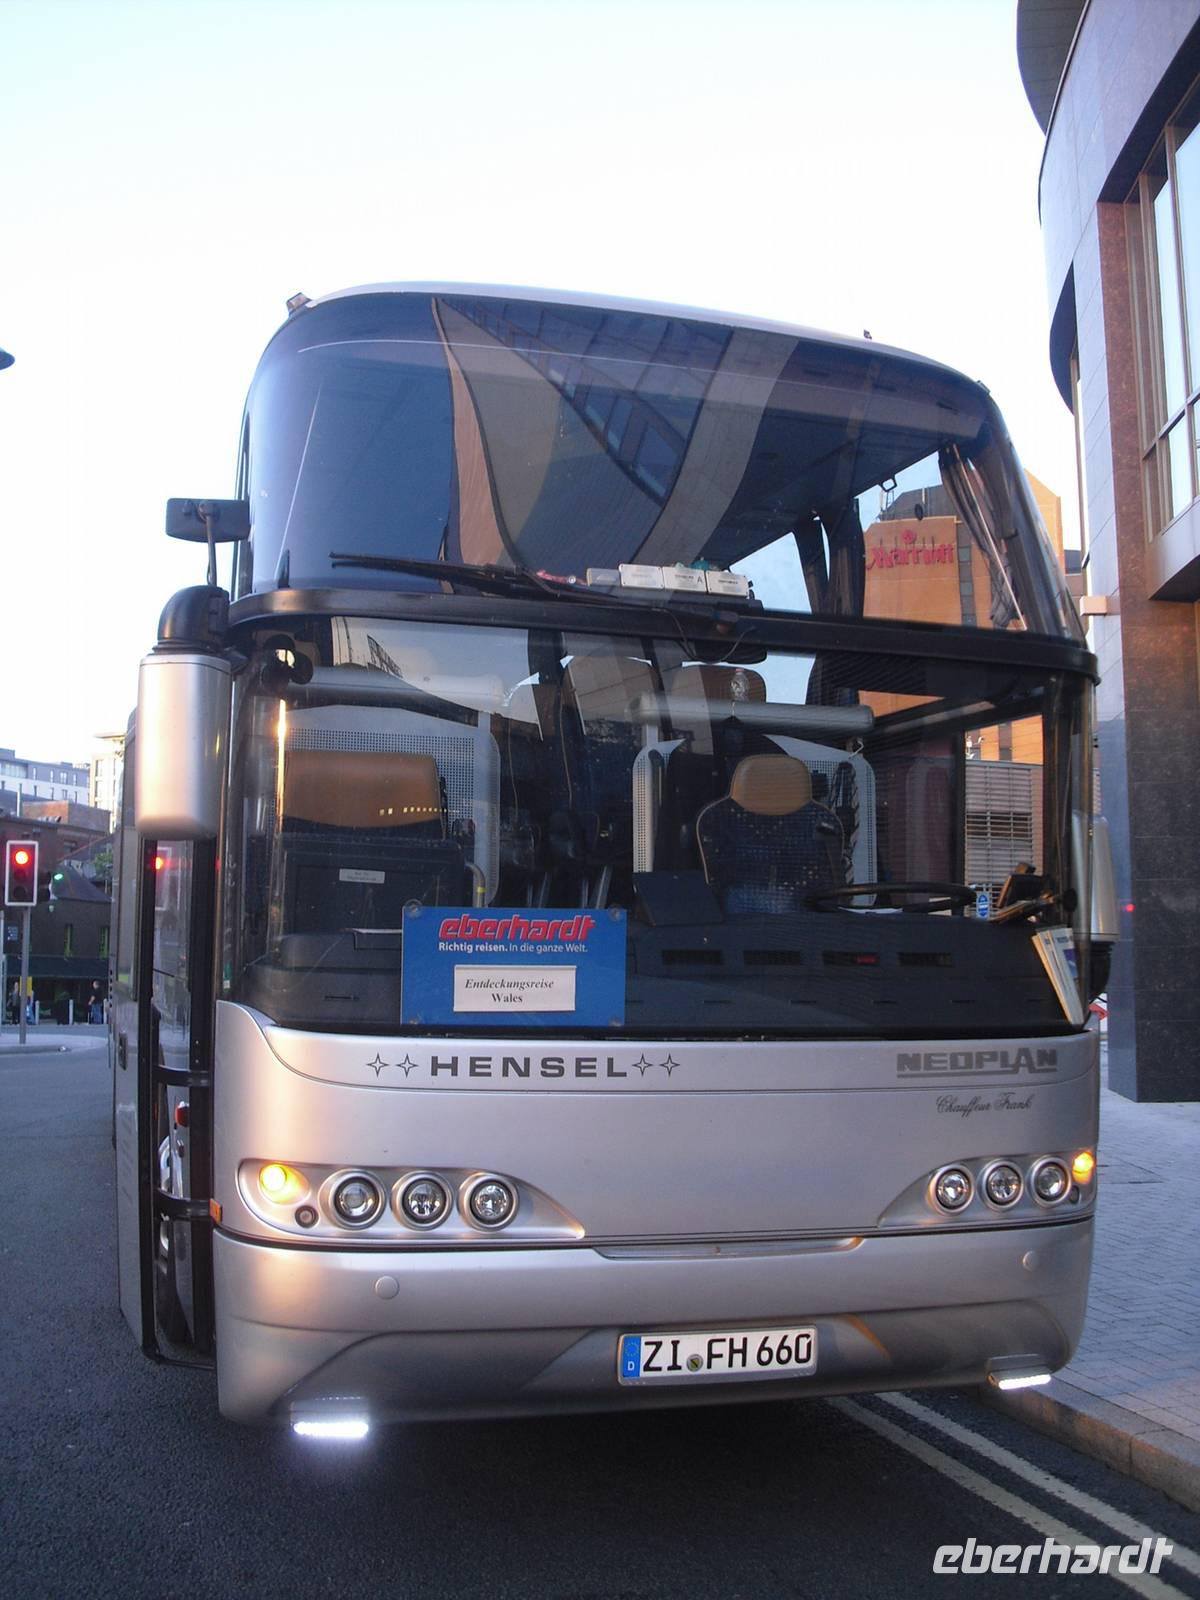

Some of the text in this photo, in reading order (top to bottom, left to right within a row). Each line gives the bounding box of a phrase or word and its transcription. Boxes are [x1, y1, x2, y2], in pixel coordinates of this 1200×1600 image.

[438, 913, 595, 941] eberhardt
[438, 942, 588, 955] Richtig reisen. In die ganze Welt.
[465, 978, 554, 991] Entdeckungsreise
[491, 993, 523, 1003] Wales
[430, 1055, 628, 1078] HENSEL
[896, 1048, 1058, 1077] NEOPLAN
[936, 1092, 1035, 1117] Chauffeur Frank
[627, 1333, 811, 1372] D ZI FH 660
